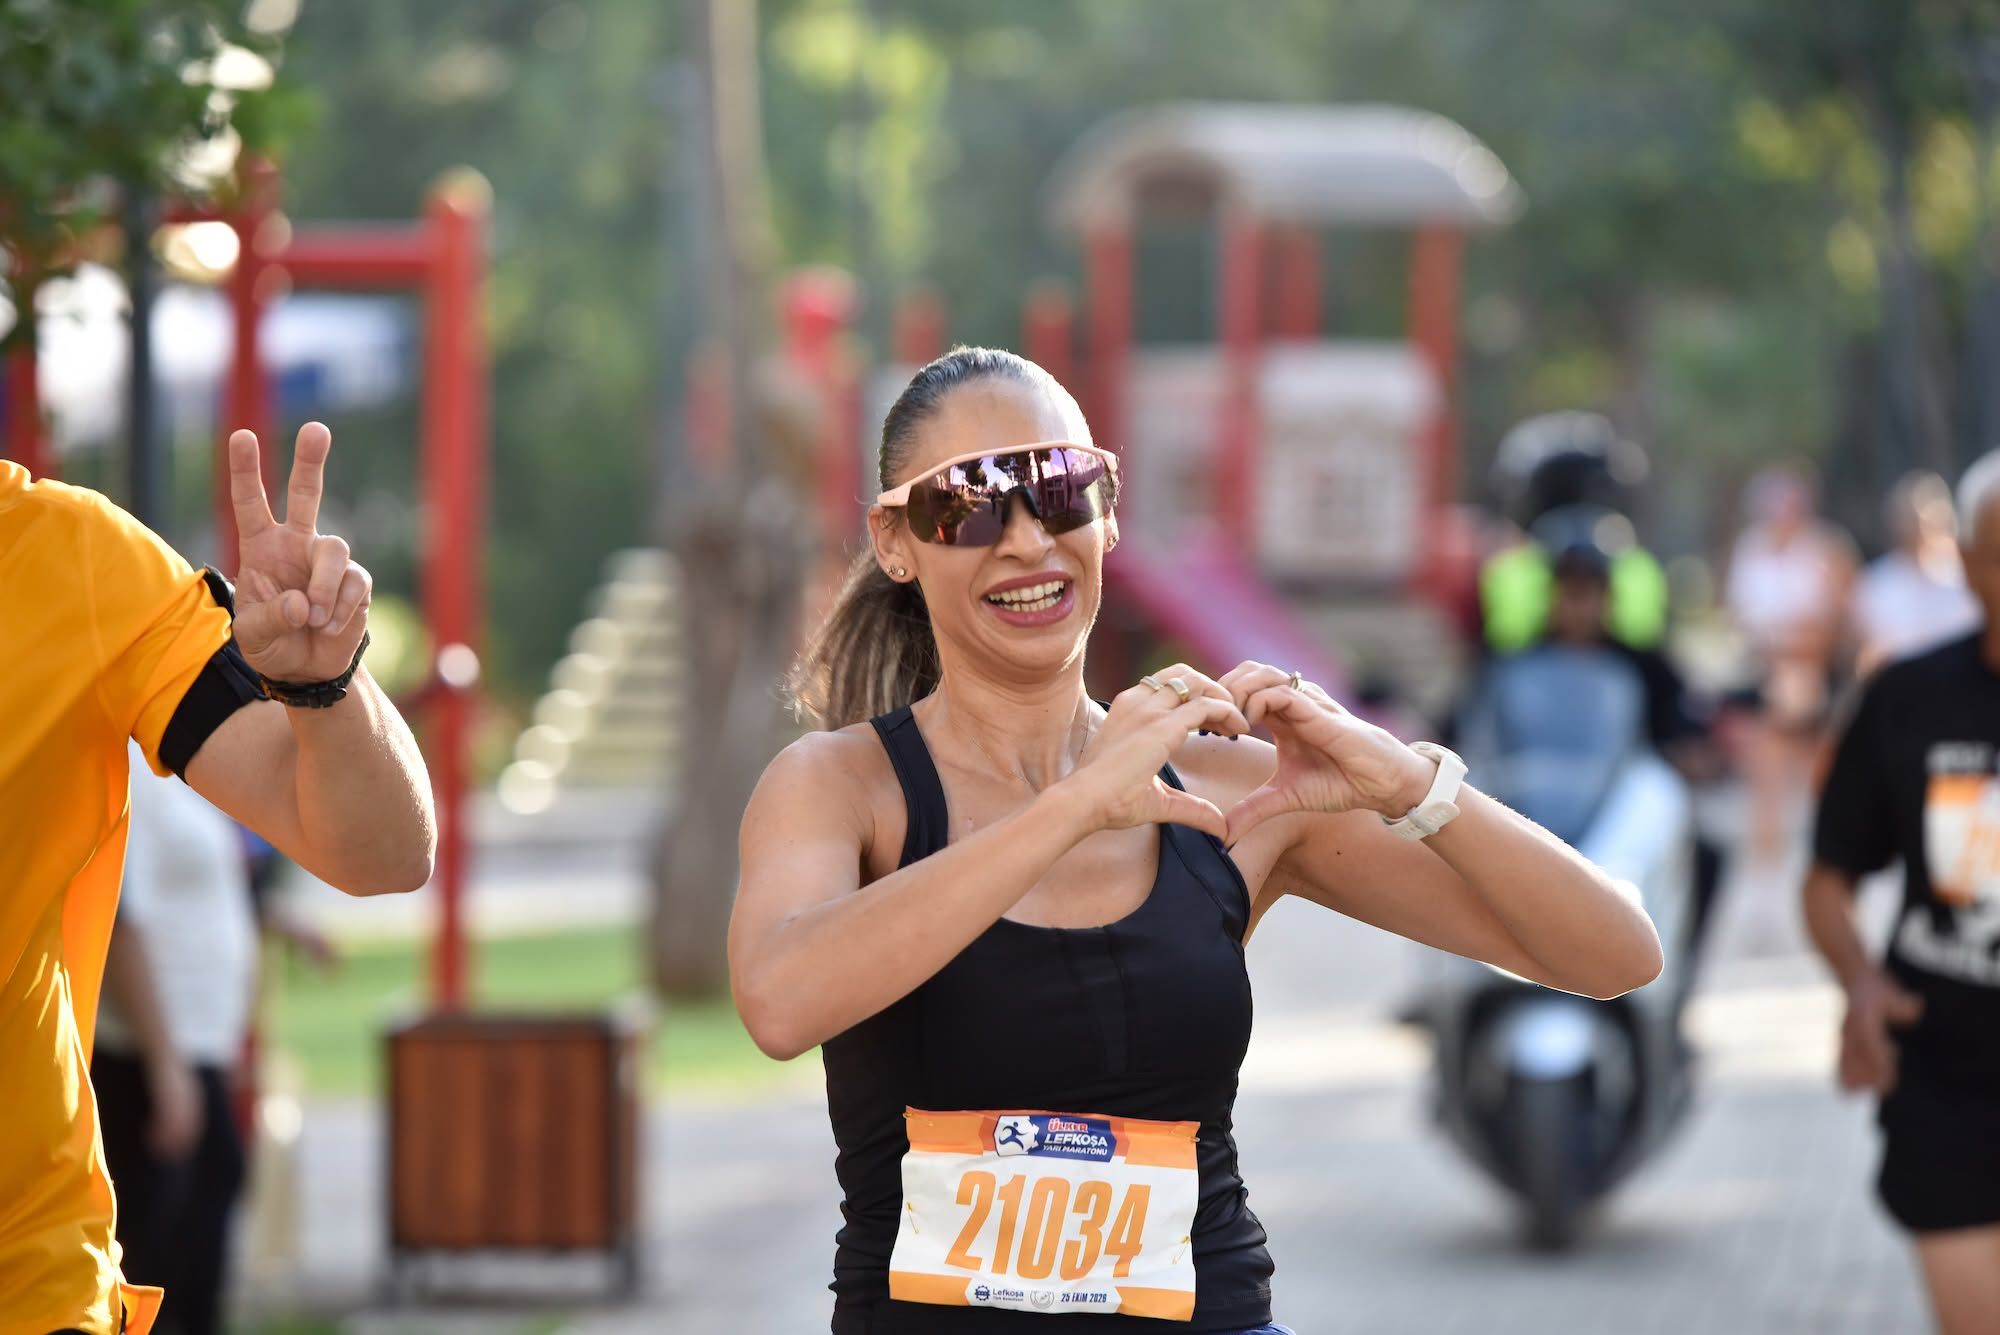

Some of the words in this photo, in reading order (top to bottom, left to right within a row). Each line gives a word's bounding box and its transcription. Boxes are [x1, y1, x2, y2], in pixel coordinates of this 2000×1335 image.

[1048, 1118, 1088, 1132] ÜLKER
[1044, 1133, 1108, 1147] LEFKOŞA
[1062, 1145, 1108, 1155] MARATONU
[945, 1171, 1151, 1281] 21034
[992, 1288, 1024, 1297] Lefkoşa
[1061, 1293, 1070, 1302] 25
